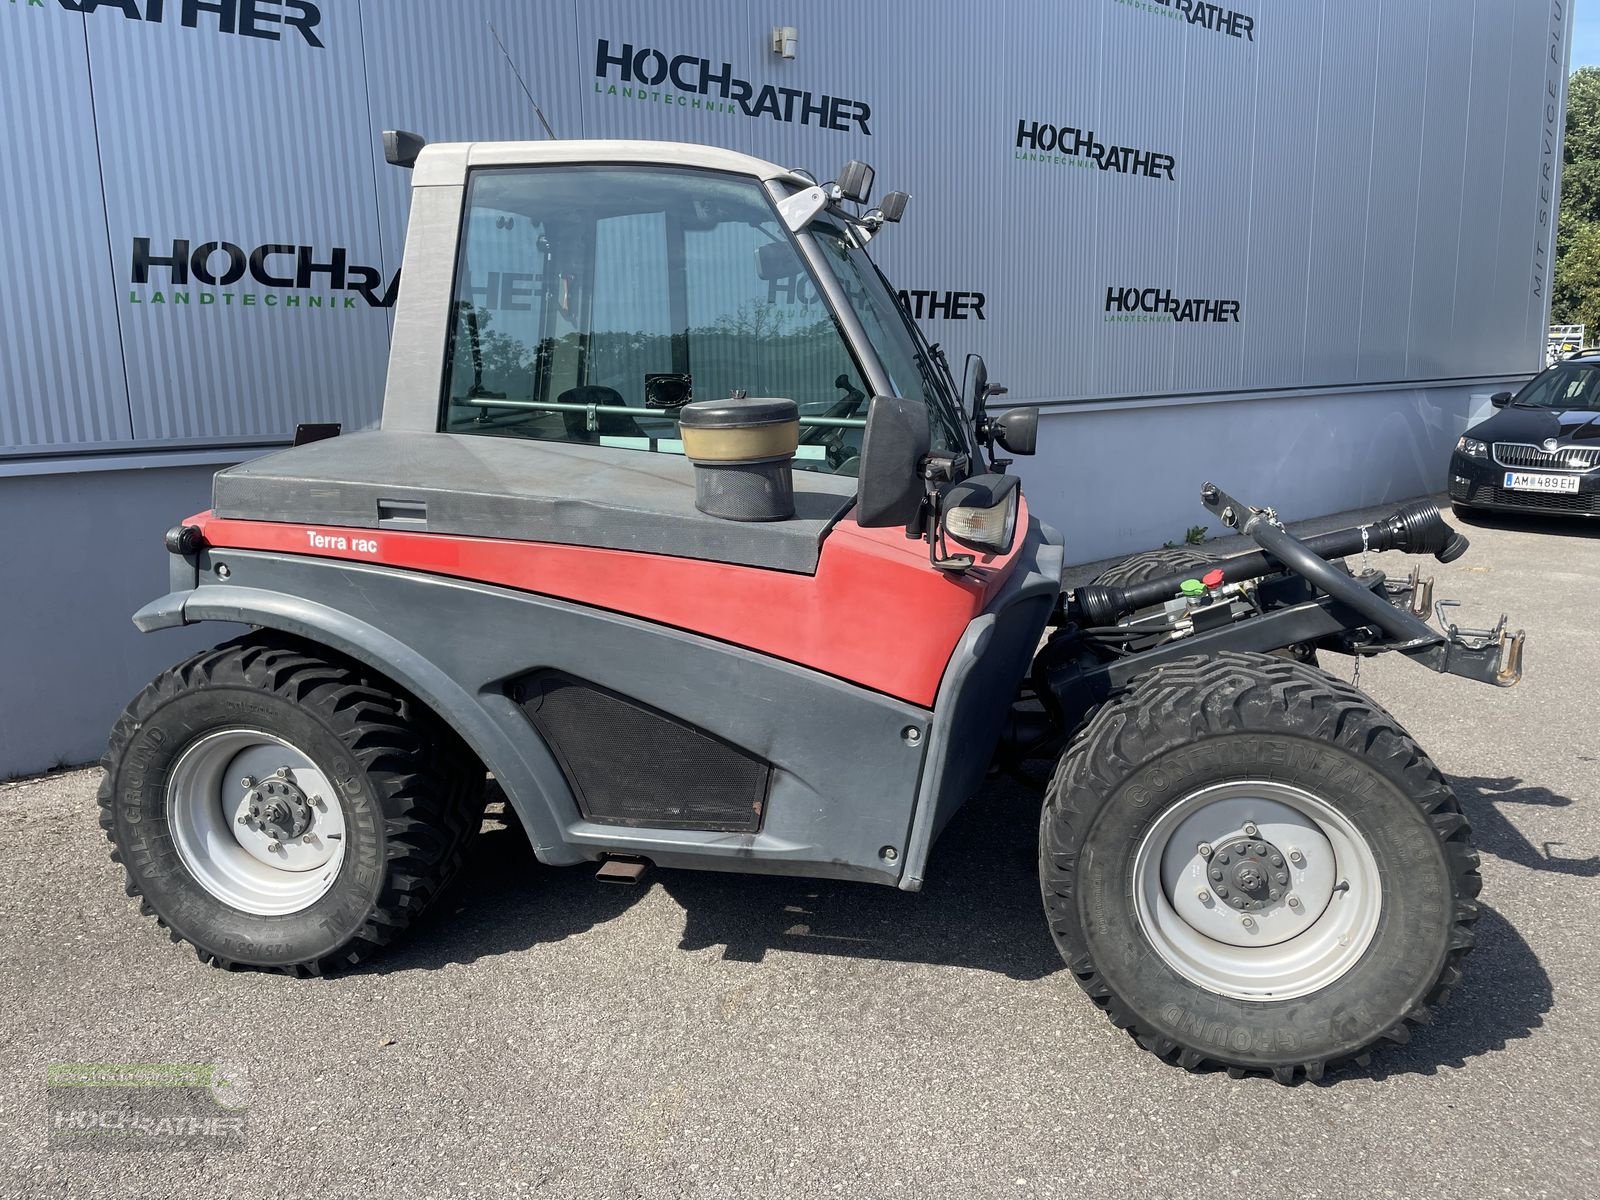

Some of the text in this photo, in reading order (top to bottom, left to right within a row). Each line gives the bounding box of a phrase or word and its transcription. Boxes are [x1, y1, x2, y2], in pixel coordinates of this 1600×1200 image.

[594, 82, 737, 115] LANDTECHNIK
[595, 39, 873, 136] HOCHRATHER
[1015, 151, 1096, 170] LANDTECHNIK
[1016, 119, 1176, 181] HOCHRATHER
[1533, 243, 1545, 298] MIT
[1539, 80, 1558, 227] SERVICE
[129, 292, 357, 309] LANDTECHNIK
[1105, 287, 1241, 323] HOCHRATHER
[1514, 476, 1529, 487] AM
[307, 530, 378, 553] Terra rac
[1125, 739, 1380, 809] CONTINENTAL
